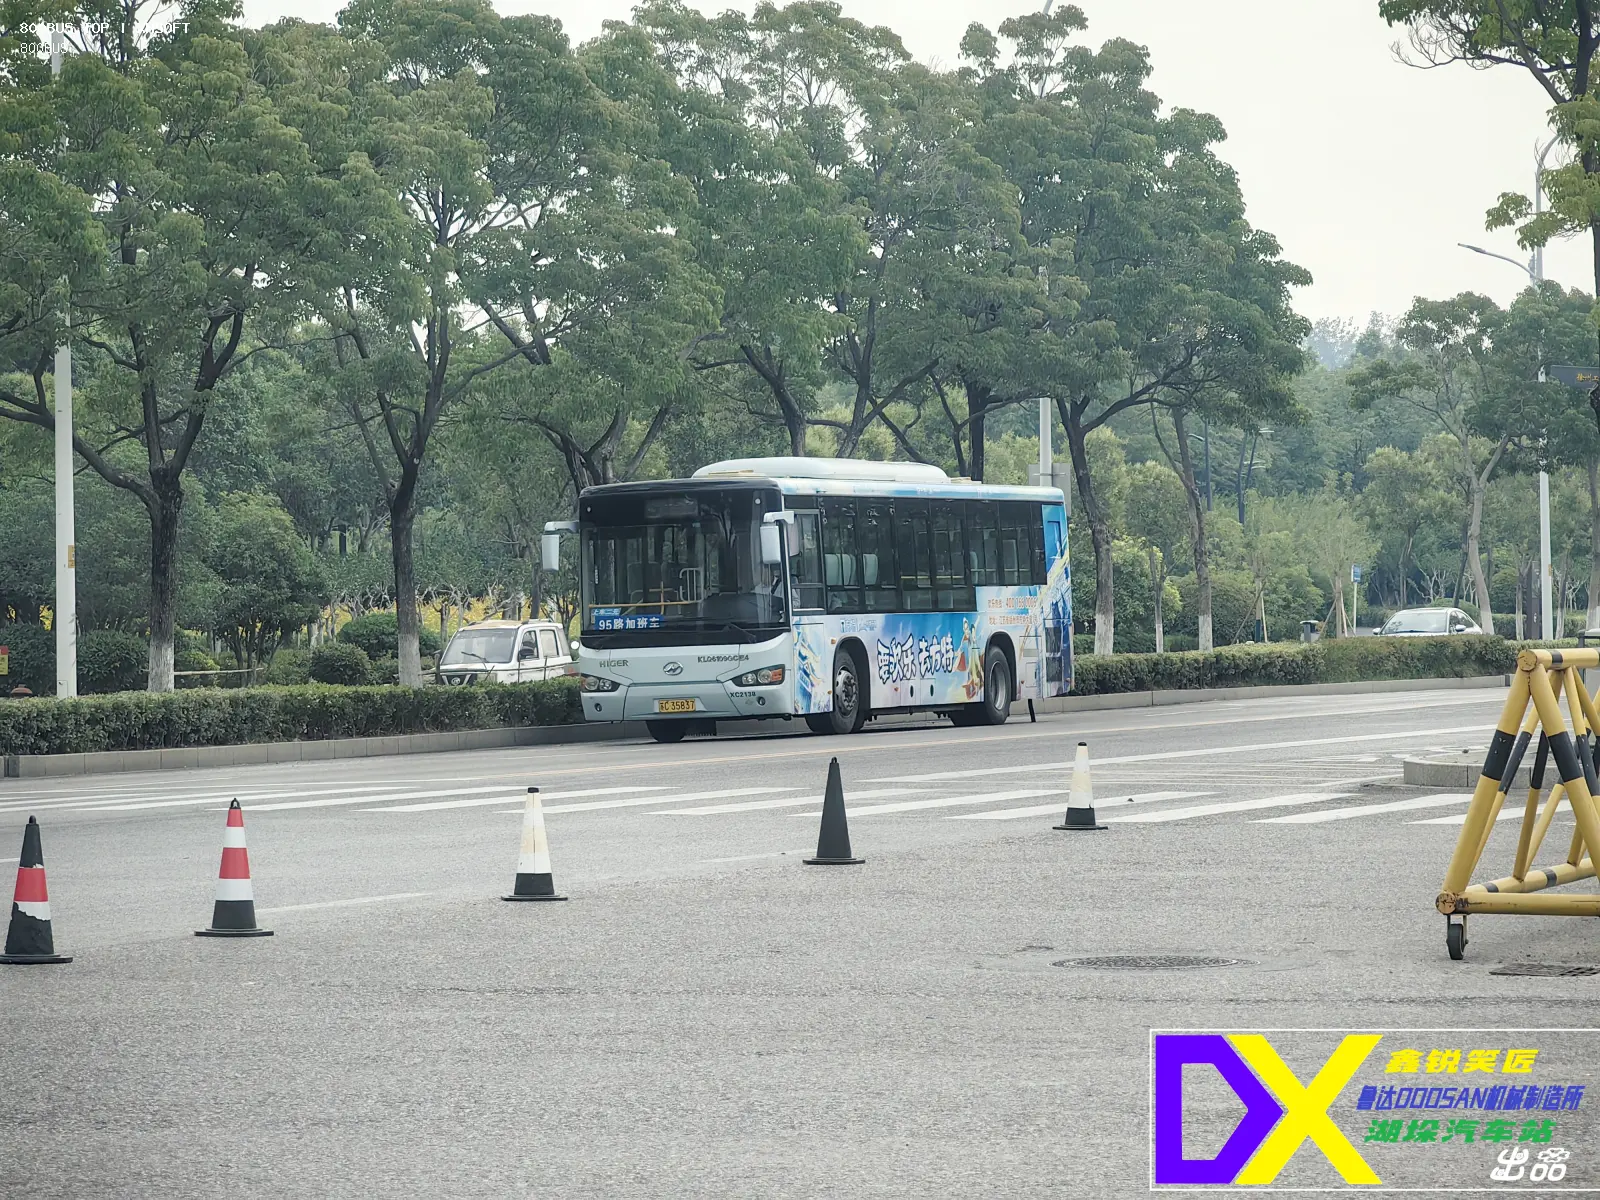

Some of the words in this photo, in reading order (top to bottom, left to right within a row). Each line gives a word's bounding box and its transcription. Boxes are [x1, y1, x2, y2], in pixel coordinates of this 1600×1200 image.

[598, 617, 660, 630] 95路加班车
[599, 660, 629, 668] HIGER
[876, 633, 917, 685] 要欢乐
[918, 632, 954, 679] 去方特
